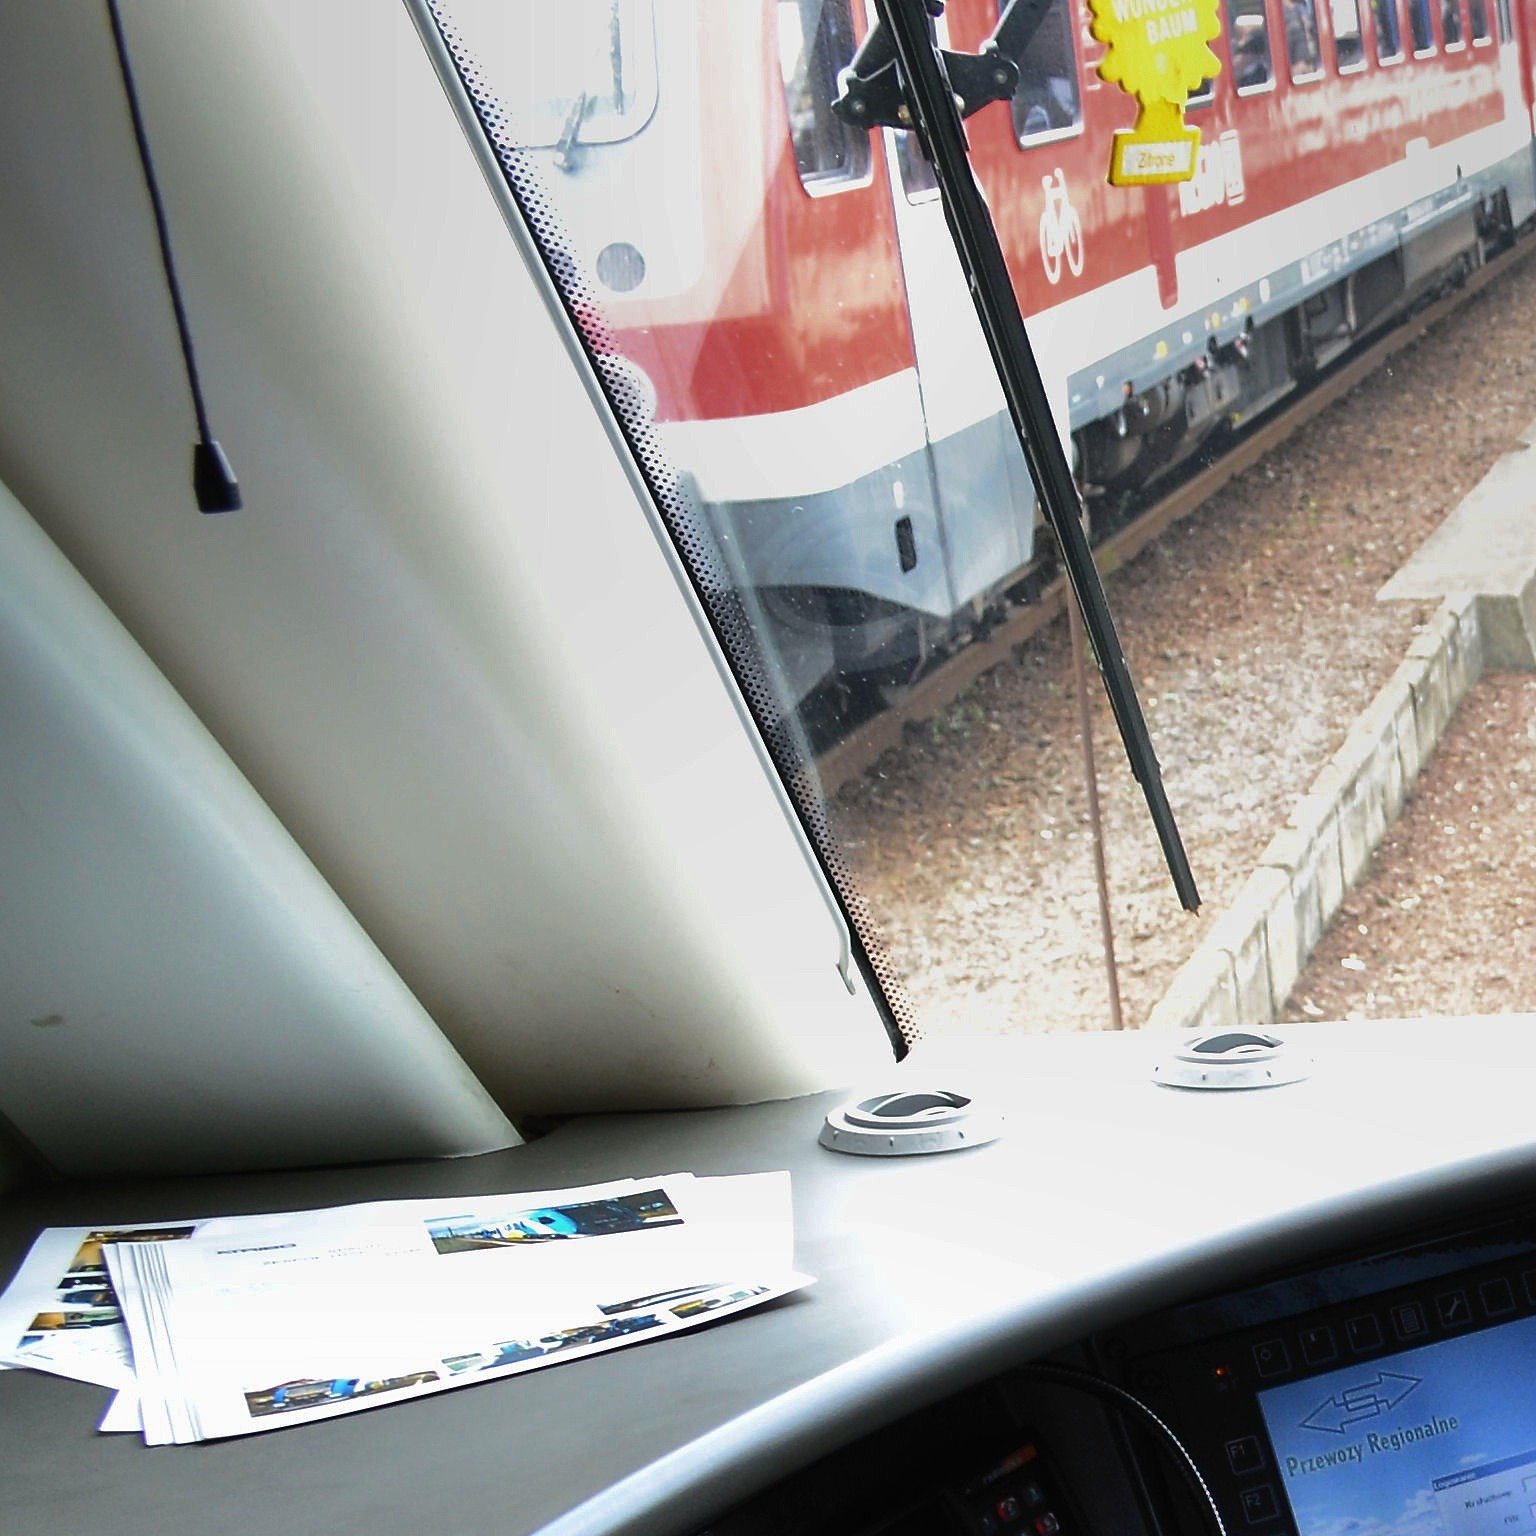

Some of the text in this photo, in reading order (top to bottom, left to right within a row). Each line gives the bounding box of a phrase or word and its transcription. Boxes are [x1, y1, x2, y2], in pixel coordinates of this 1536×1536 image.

[1147, 9, 1197, 44] BAUM
[1136, 151, 1176, 169] Zitrone
[1286, 1415, 1459, 1477] Przewozy Regionalne
